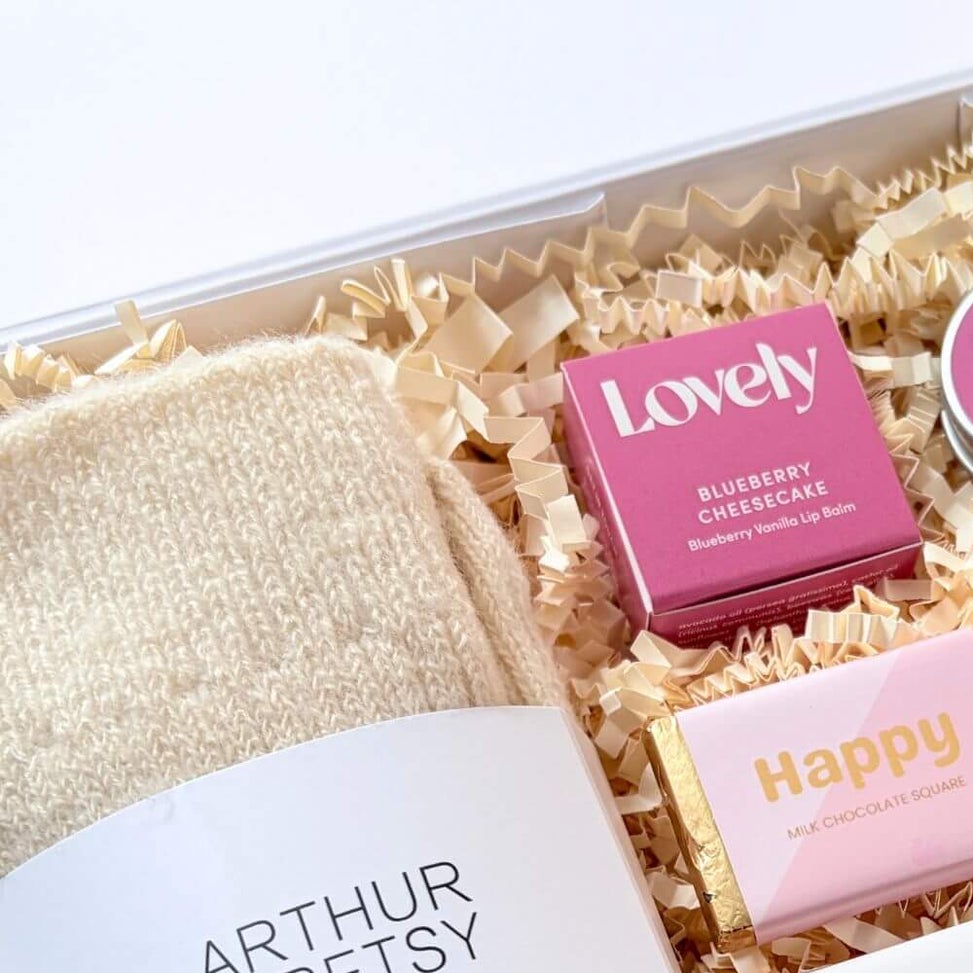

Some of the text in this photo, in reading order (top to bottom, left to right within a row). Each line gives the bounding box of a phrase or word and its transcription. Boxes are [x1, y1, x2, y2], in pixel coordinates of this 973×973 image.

[600, 343, 817, 438] Lovely
[697, 461, 812, 503] BLUEBERRY
[697, 480, 828, 525] CHEESECAKE
[688, 502, 856, 552] Blueberry Vanilla Lip Balm
[754, 712, 960, 803] Happy
[787, 775, 967, 841] MILK CHOCOLATE SQUARE
